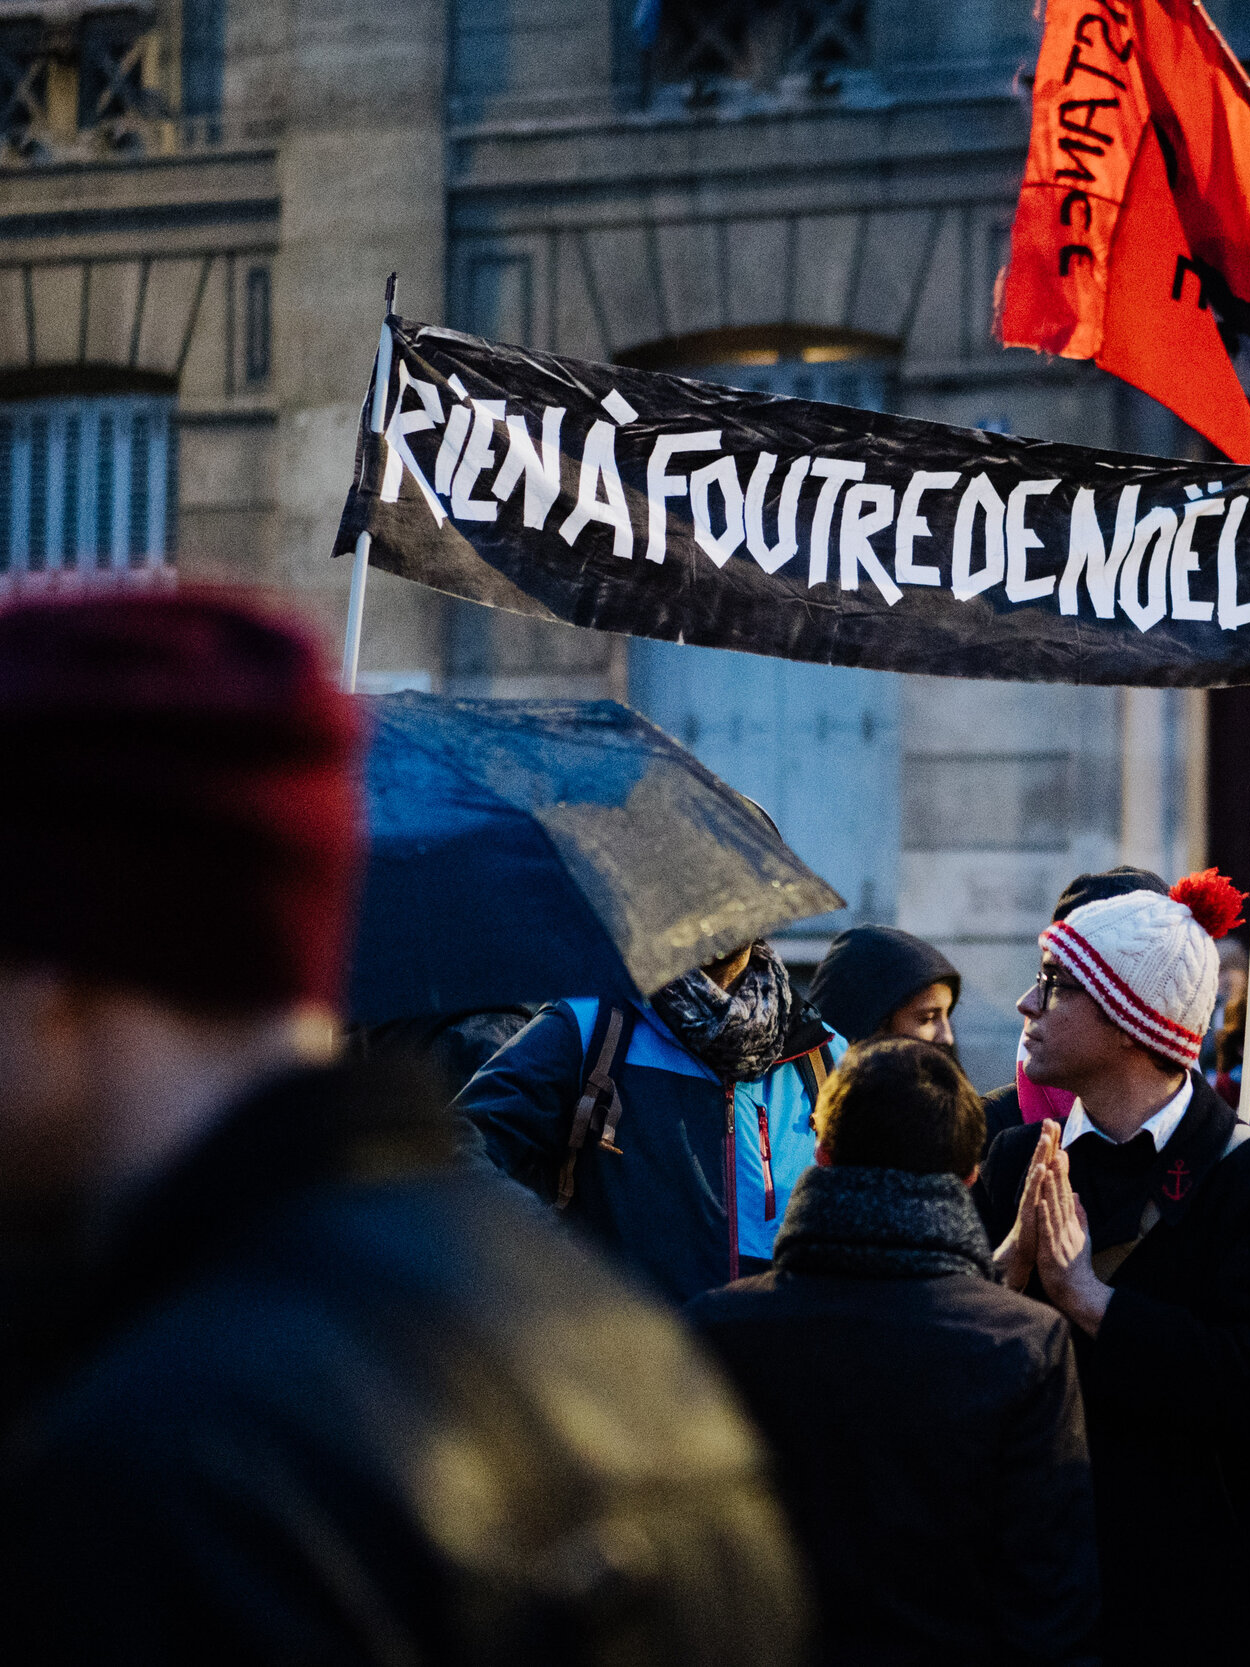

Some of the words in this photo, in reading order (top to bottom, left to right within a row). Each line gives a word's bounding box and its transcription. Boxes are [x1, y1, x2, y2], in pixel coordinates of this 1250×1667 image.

[380, 358, 566, 531] RIEN
[558, 388, 639, 560] À
[636, 430, 961, 607] FOUTRE
[951, 472, 1062, 603] DE
